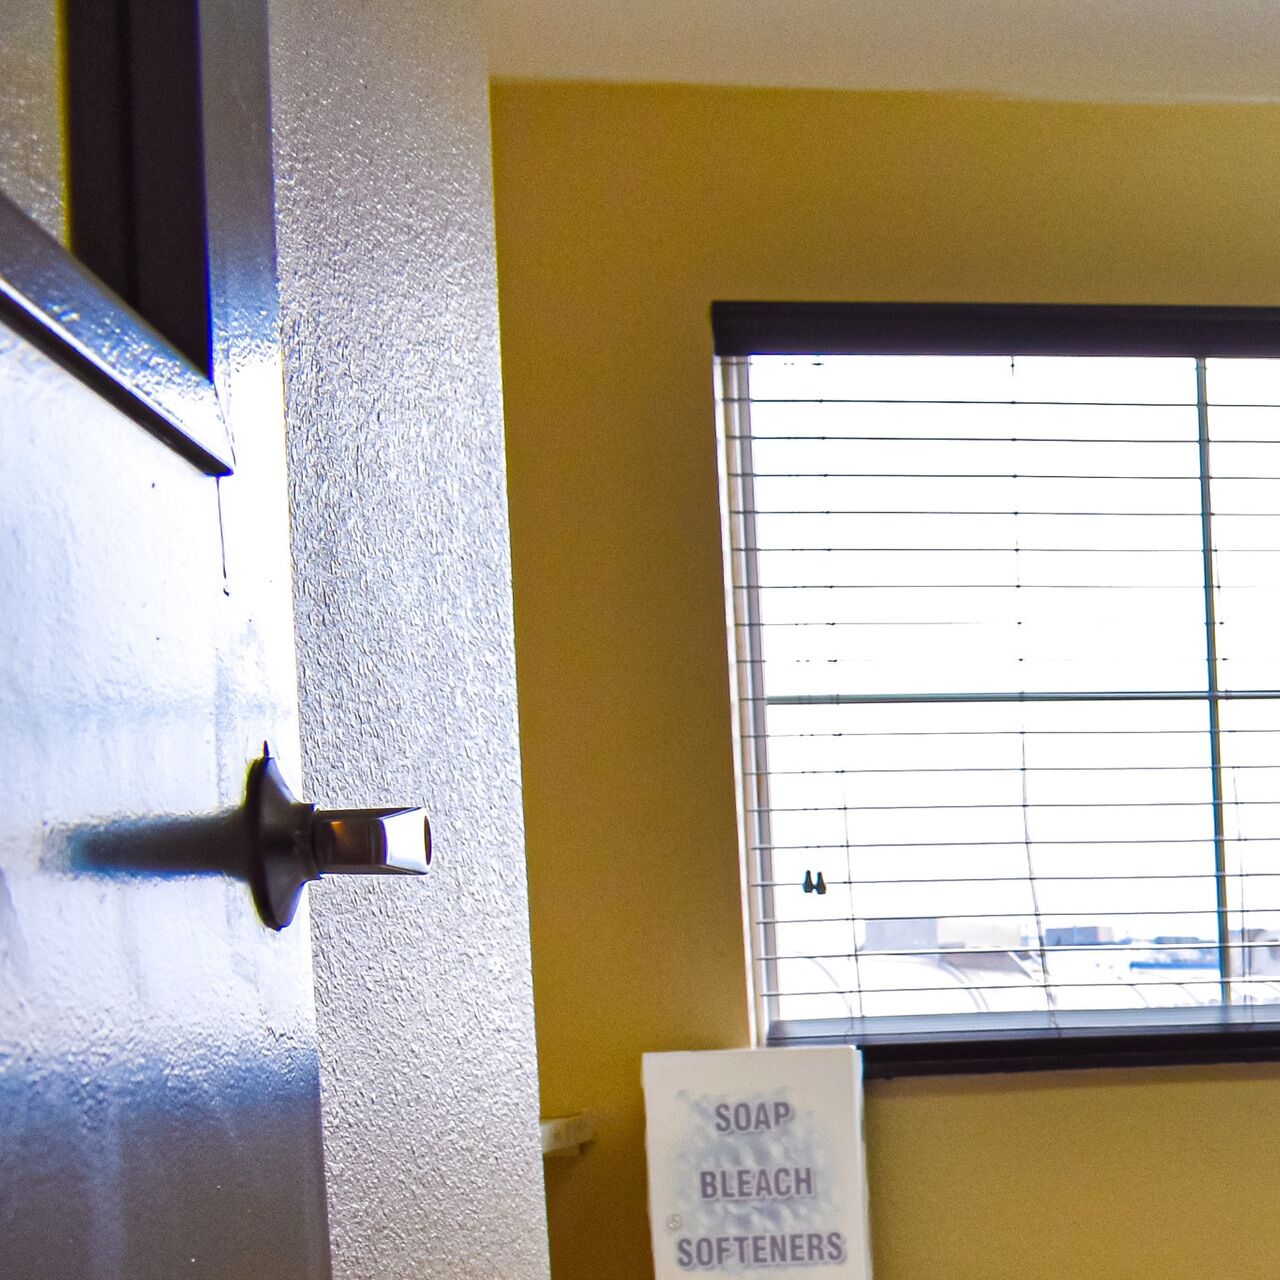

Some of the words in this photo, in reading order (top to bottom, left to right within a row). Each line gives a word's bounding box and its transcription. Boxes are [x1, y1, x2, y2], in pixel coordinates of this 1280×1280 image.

[715, 1101, 791, 1133] SOAP
[700, 1167, 813, 1200] BLEACH
[677, 1232, 844, 1268] SOFTENERS
